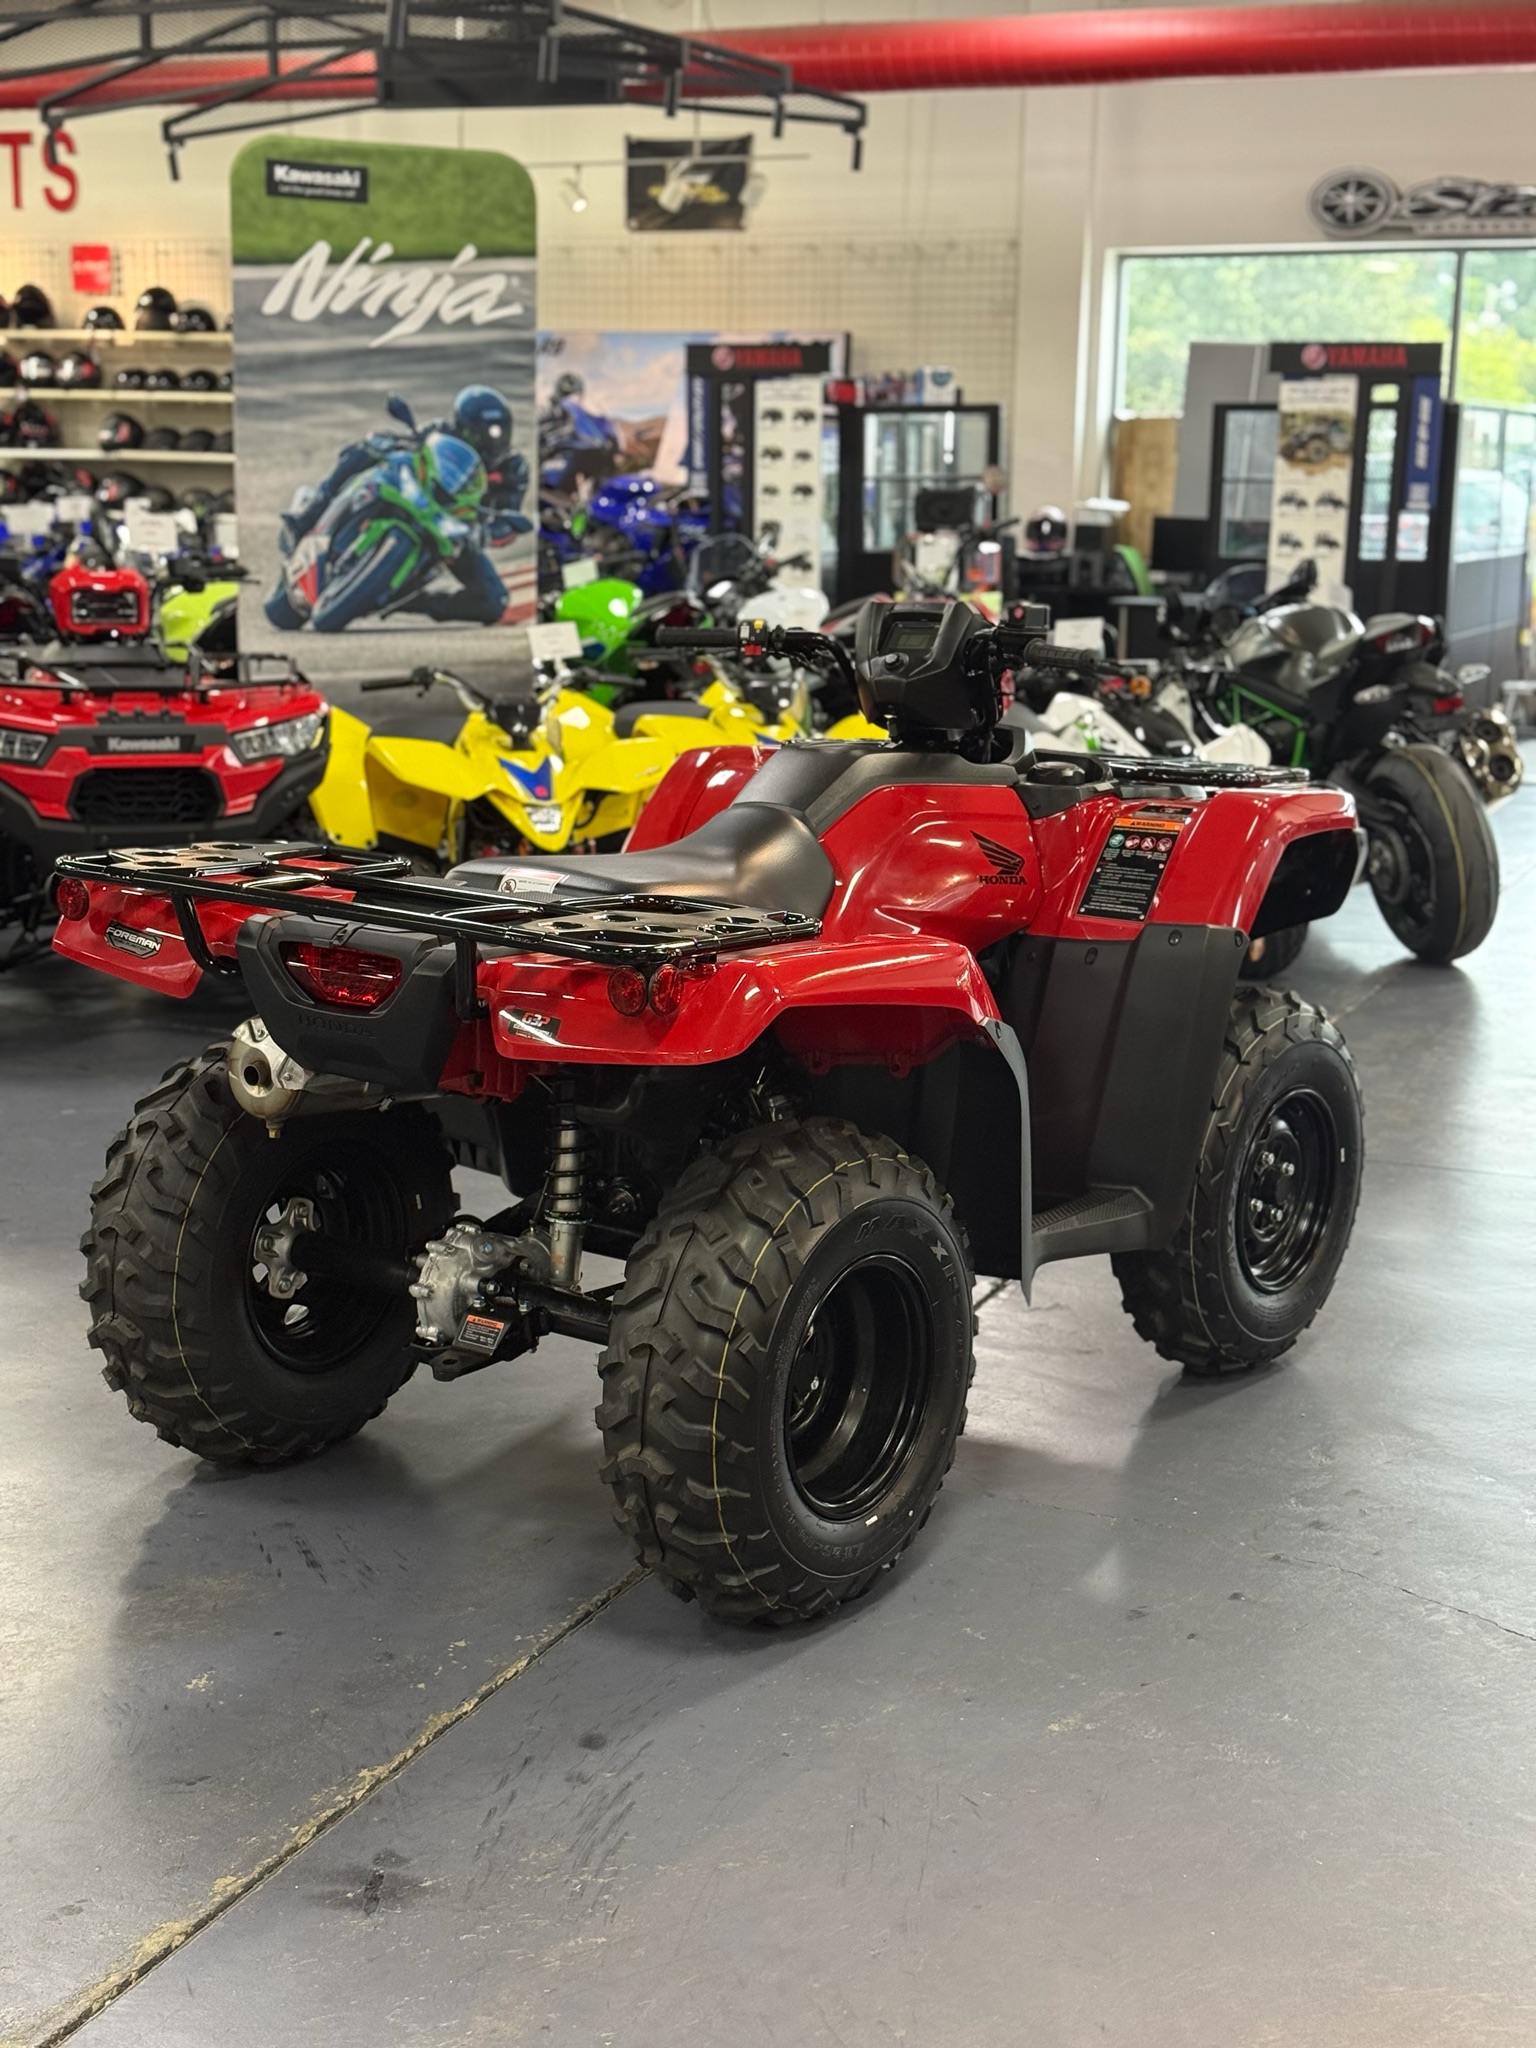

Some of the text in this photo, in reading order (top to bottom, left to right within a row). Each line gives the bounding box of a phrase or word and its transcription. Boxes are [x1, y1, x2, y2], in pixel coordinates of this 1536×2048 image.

[273, 164, 362, 189] Kawasaki
[260, 236, 524, 348] Ninja
[1327, 345, 1408, 367] YAMAHA
[107, 736, 181, 752] Kawasaki
[978, 875, 1028, 885] HONDA
[105, 926, 161, 951] FOREMAN
[297, 1014, 377, 1039] HONDA
